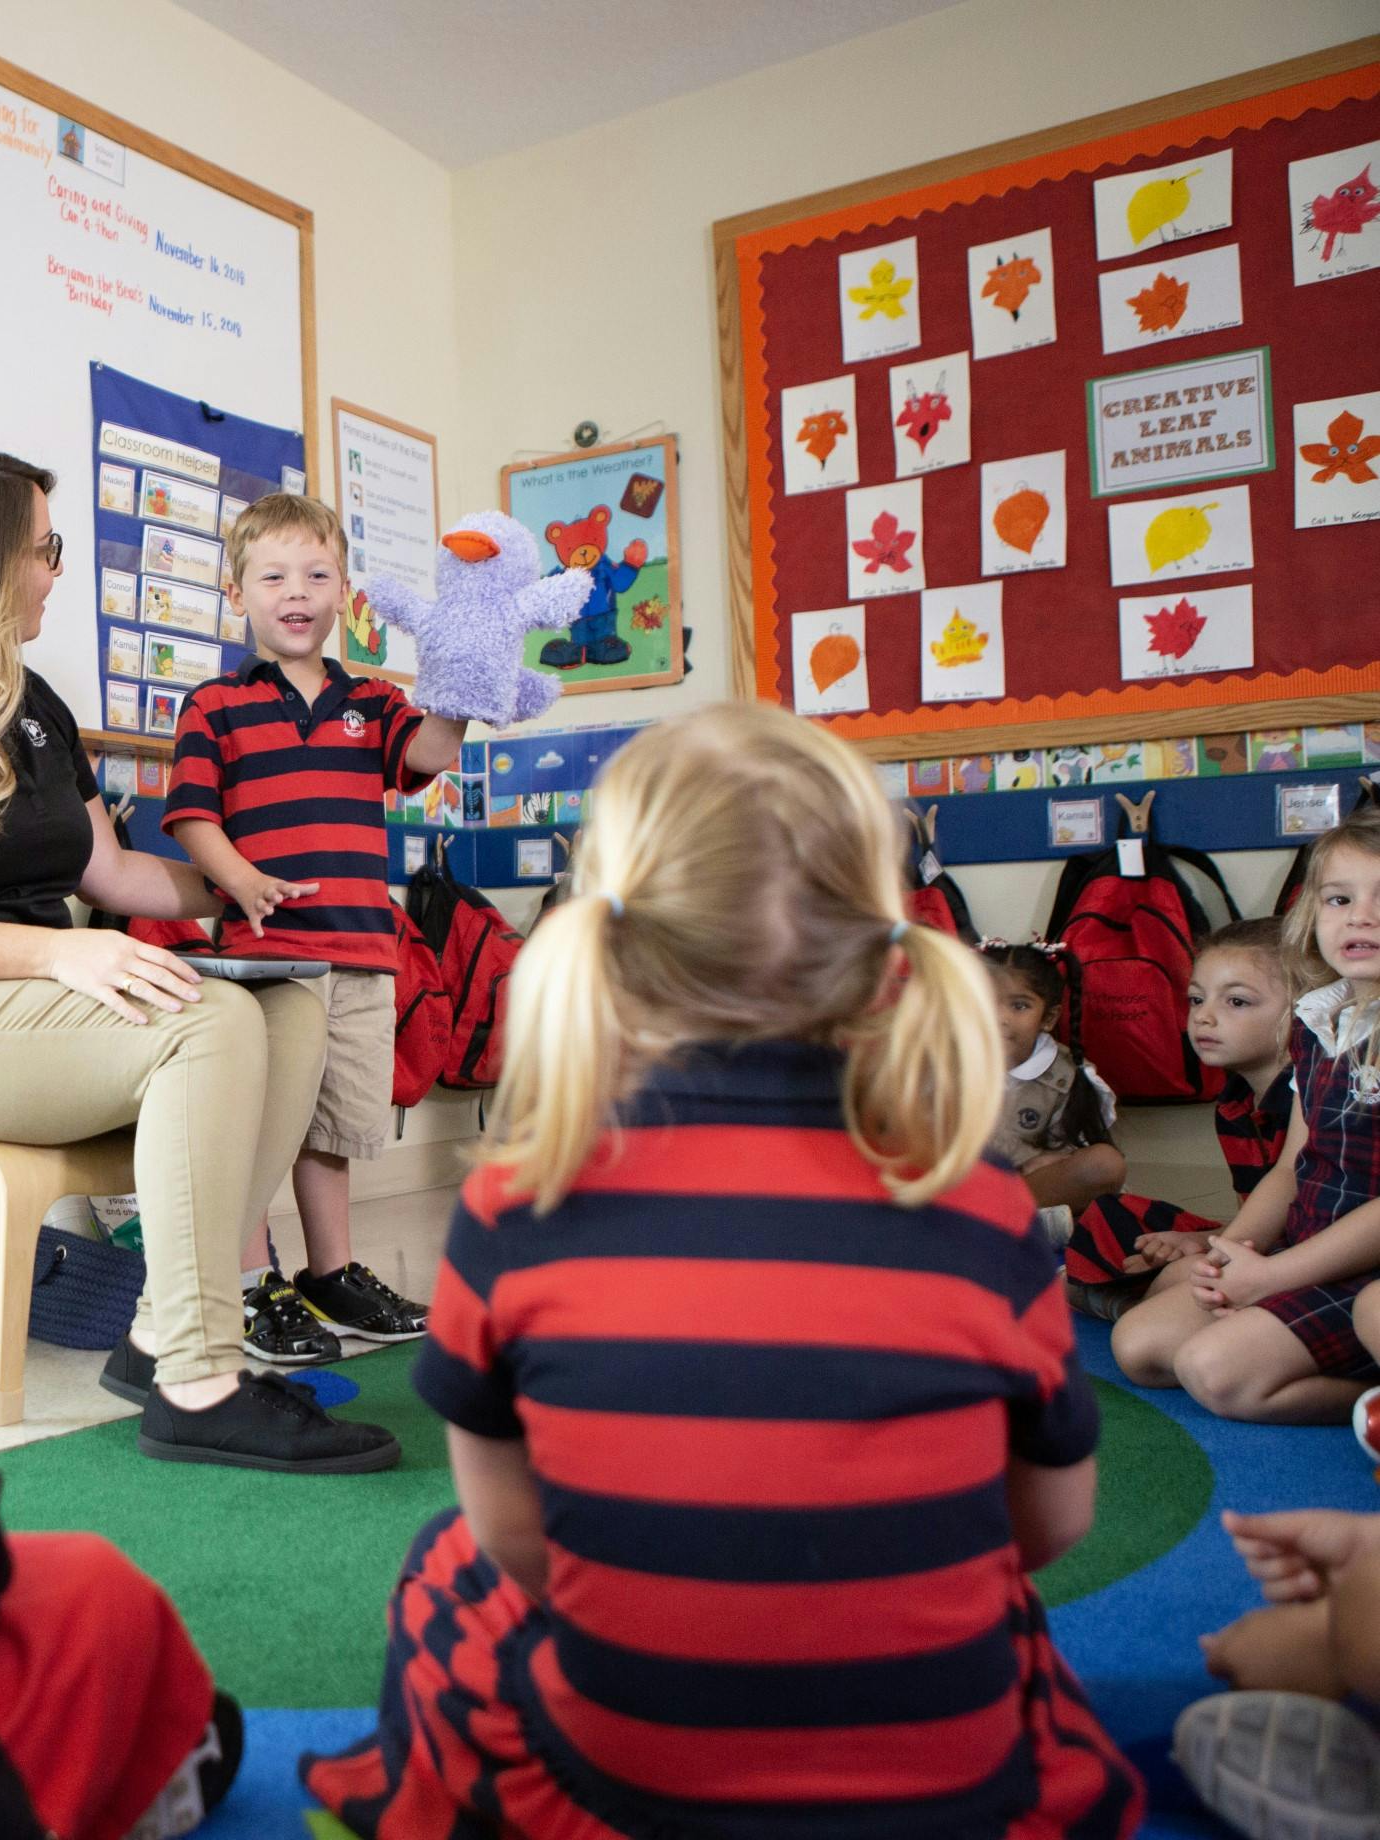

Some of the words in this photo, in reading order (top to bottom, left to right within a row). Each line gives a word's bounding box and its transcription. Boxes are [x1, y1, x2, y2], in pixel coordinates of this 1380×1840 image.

[21, 106, 40, 136] for
[47, 174, 88, 214] Caring
[92, 199, 112, 218] and
[115, 204, 149, 244] Giving
[59, 202, 79, 224] Can
[47, 254, 94, 288] Benjamin
[97, 274, 113, 294] the
[155, 229, 205, 270] November
[223, 263, 247, 286] 2018
[65, 283, 114, 317] Birthday
[148, 293, 195, 326] November
[220, 317, 243, 338] 2018
[1102, 376, 1256, 419] CREATIVE
[1139, 409, 1217, 439] LEAF
[102, 428, 174, 462] Classroom
[176, 448, 219, 478] Helpers
[1110, 429, 1252, 470] ANIMALS
[521, 471, 554, 489] What
[557, 468, 565, 483] is
[568, 464, 589, 481] the
[592, 454, 653, 477] Weather?
[106, 579, 133, 592] Connor
[113, 639, 139, 651] Kamila
